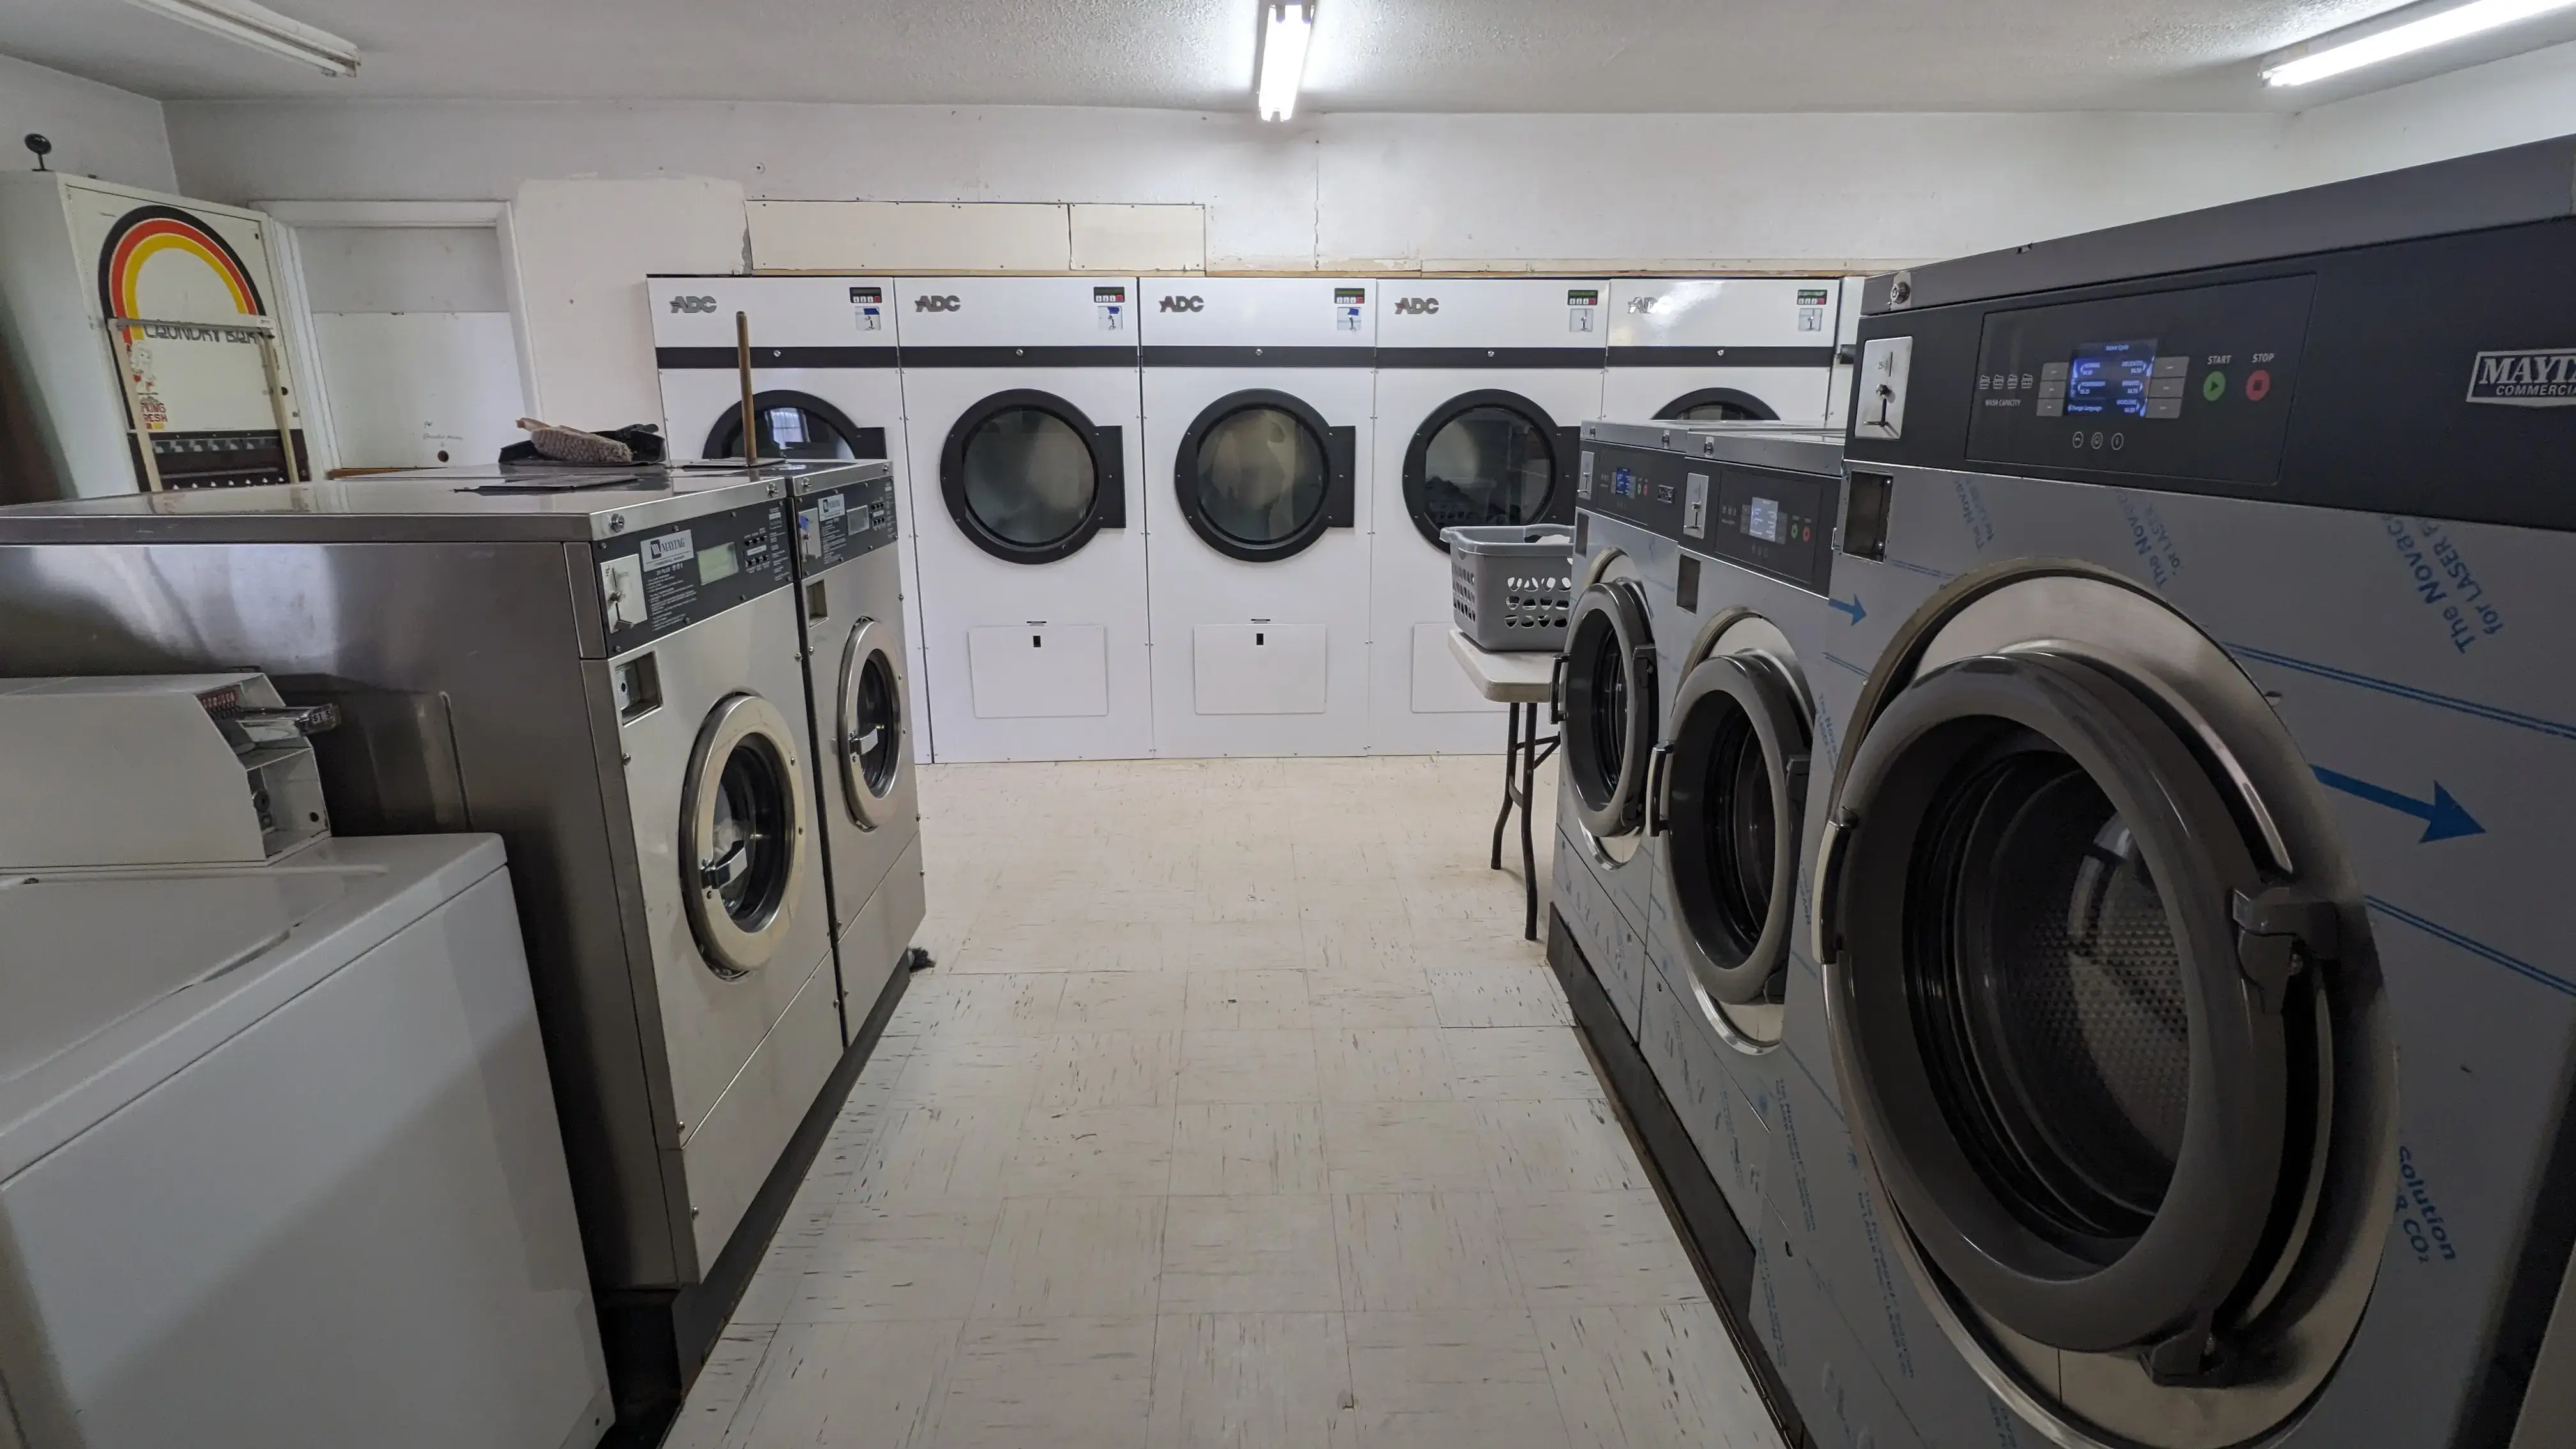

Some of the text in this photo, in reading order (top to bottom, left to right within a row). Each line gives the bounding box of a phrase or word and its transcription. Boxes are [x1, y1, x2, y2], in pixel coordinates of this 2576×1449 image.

[669, 296, 717, 313] ADC
[914, 295, 961, 312] ADC
[1158, 295, 1204, 312] ADC
[1394, 297, 1439, 314] ADC
[1627, 296, 1661, 314] AD
[2207, 355, 2232, 365] START
[2251, 353, 2274, 363] STOP
[2432, 536, 2482, 602] LASER
[2474, 604, 2504, 635] for
[2442, 606, 2476, 654] The
[2399, 1146, 2456, 1260] solution
